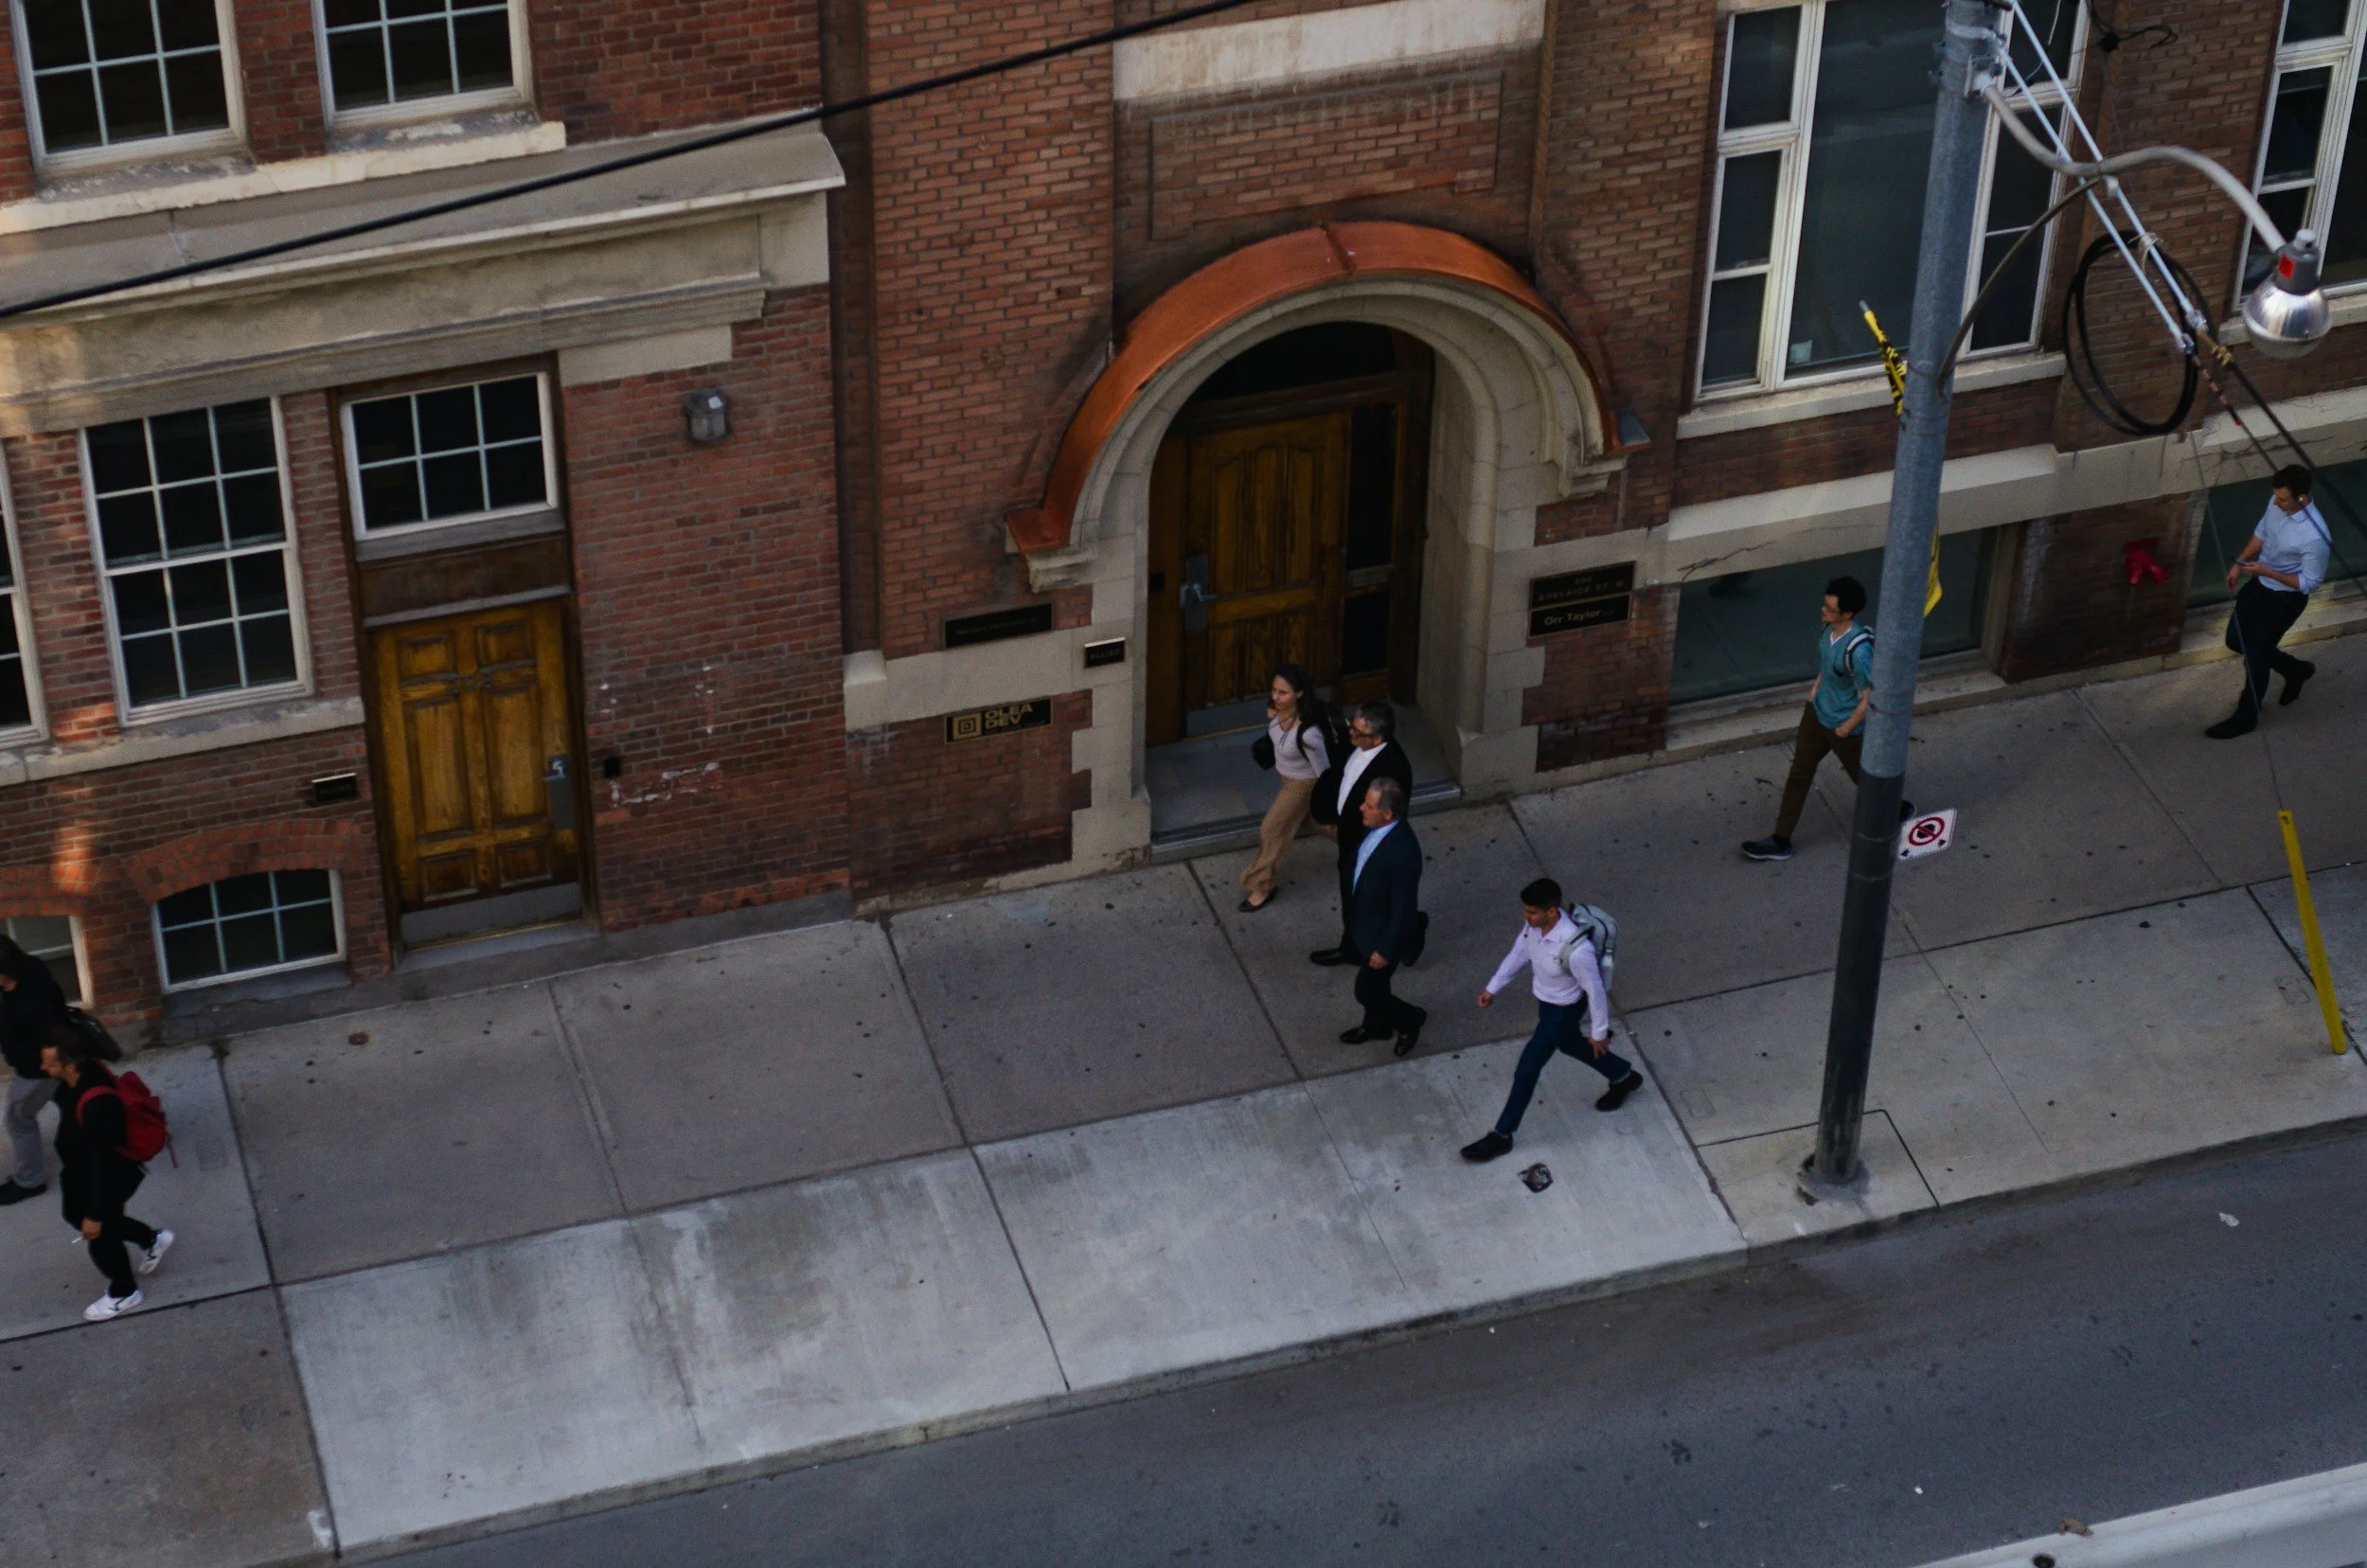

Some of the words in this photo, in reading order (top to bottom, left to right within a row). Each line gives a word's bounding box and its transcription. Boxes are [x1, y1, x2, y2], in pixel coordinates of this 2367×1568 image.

[1538, 585, 1591, 601] ADELAIDE
[1543, 615, 1563, 626] Orr
[1567, 609, 1602, 622] Taylor
